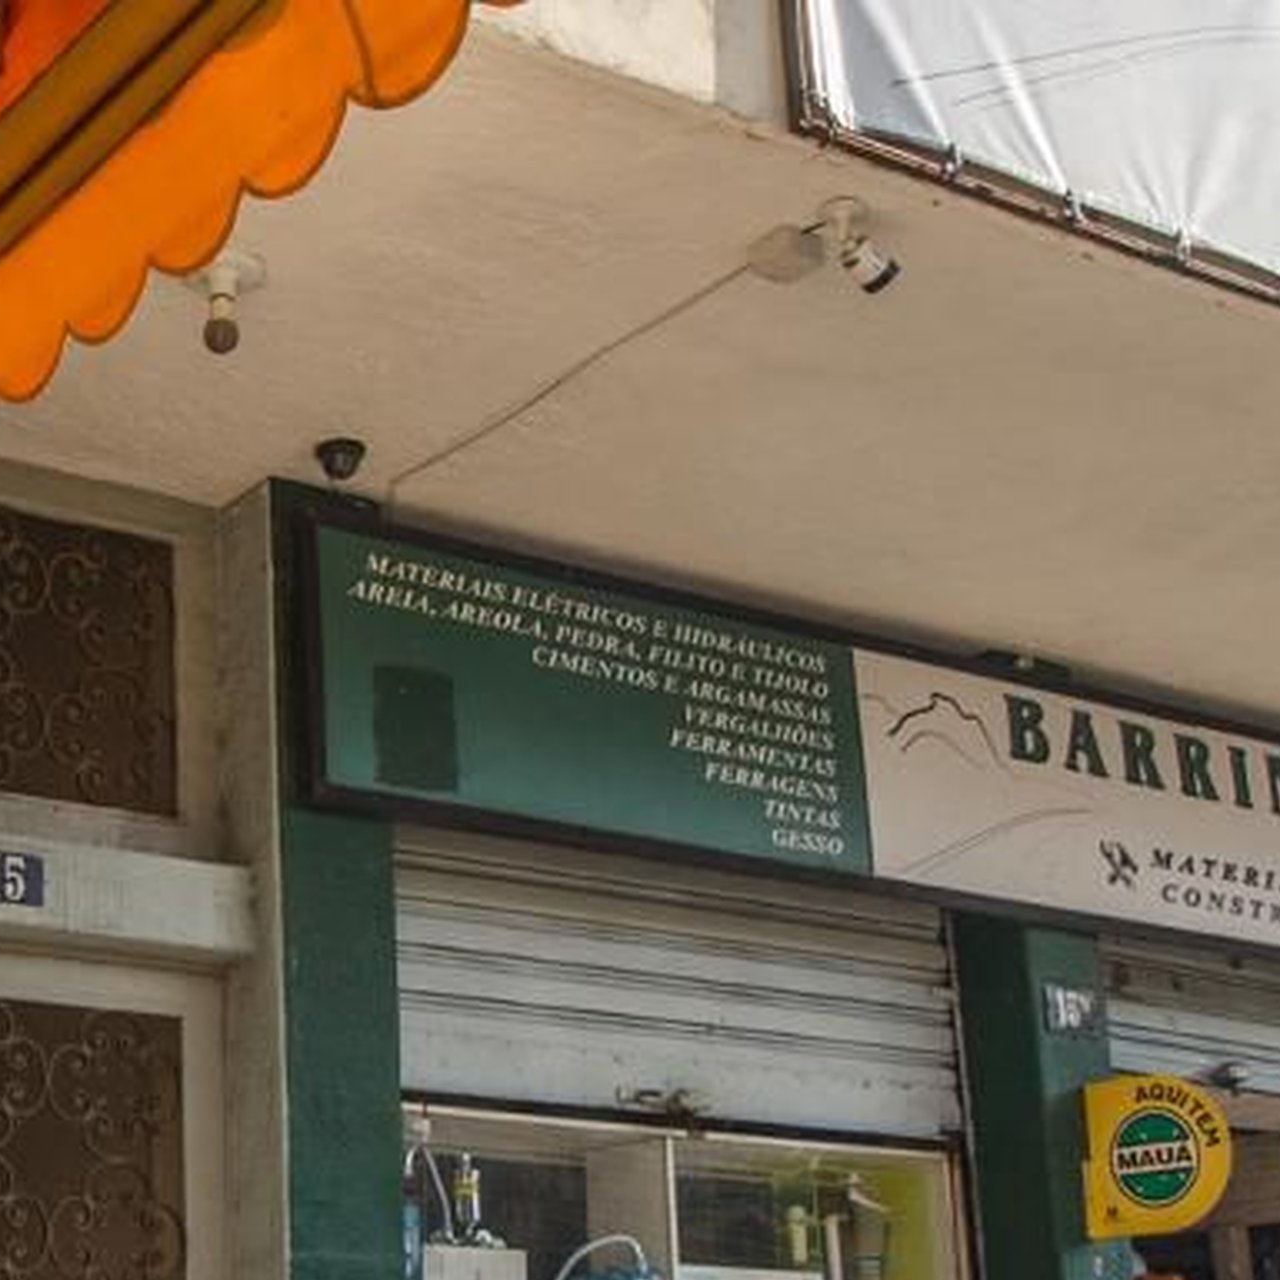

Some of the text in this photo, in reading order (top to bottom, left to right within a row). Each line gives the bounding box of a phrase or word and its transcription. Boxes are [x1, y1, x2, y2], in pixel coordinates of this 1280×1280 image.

[366, 552, 826, 674] MATERIAIS ELÉTRICOS E HIDRÁULICOS
[347, 581, 437, 616] AREIA,
[441, 600, 549, 641] AREOLA,
[555, 625, 641, 661] PEDRA,
[731, 662, 746, 681] E
[754, 666, 829, 699] TIJOLO
[531, 645, 832, 725] CIMENTOS E ARGAMASSAS
[685, 703, 835, 751] VERGALHÕES
[671, 728, 837, 777] FERRAMENTAS
[704, 761, 838, 802] FERRAGENS
[764, 799, 841, 829] TINTAS
[771, 828, 844, 856] GESSO
[1135, 1083, 1221, 1148] AQUI TEM
